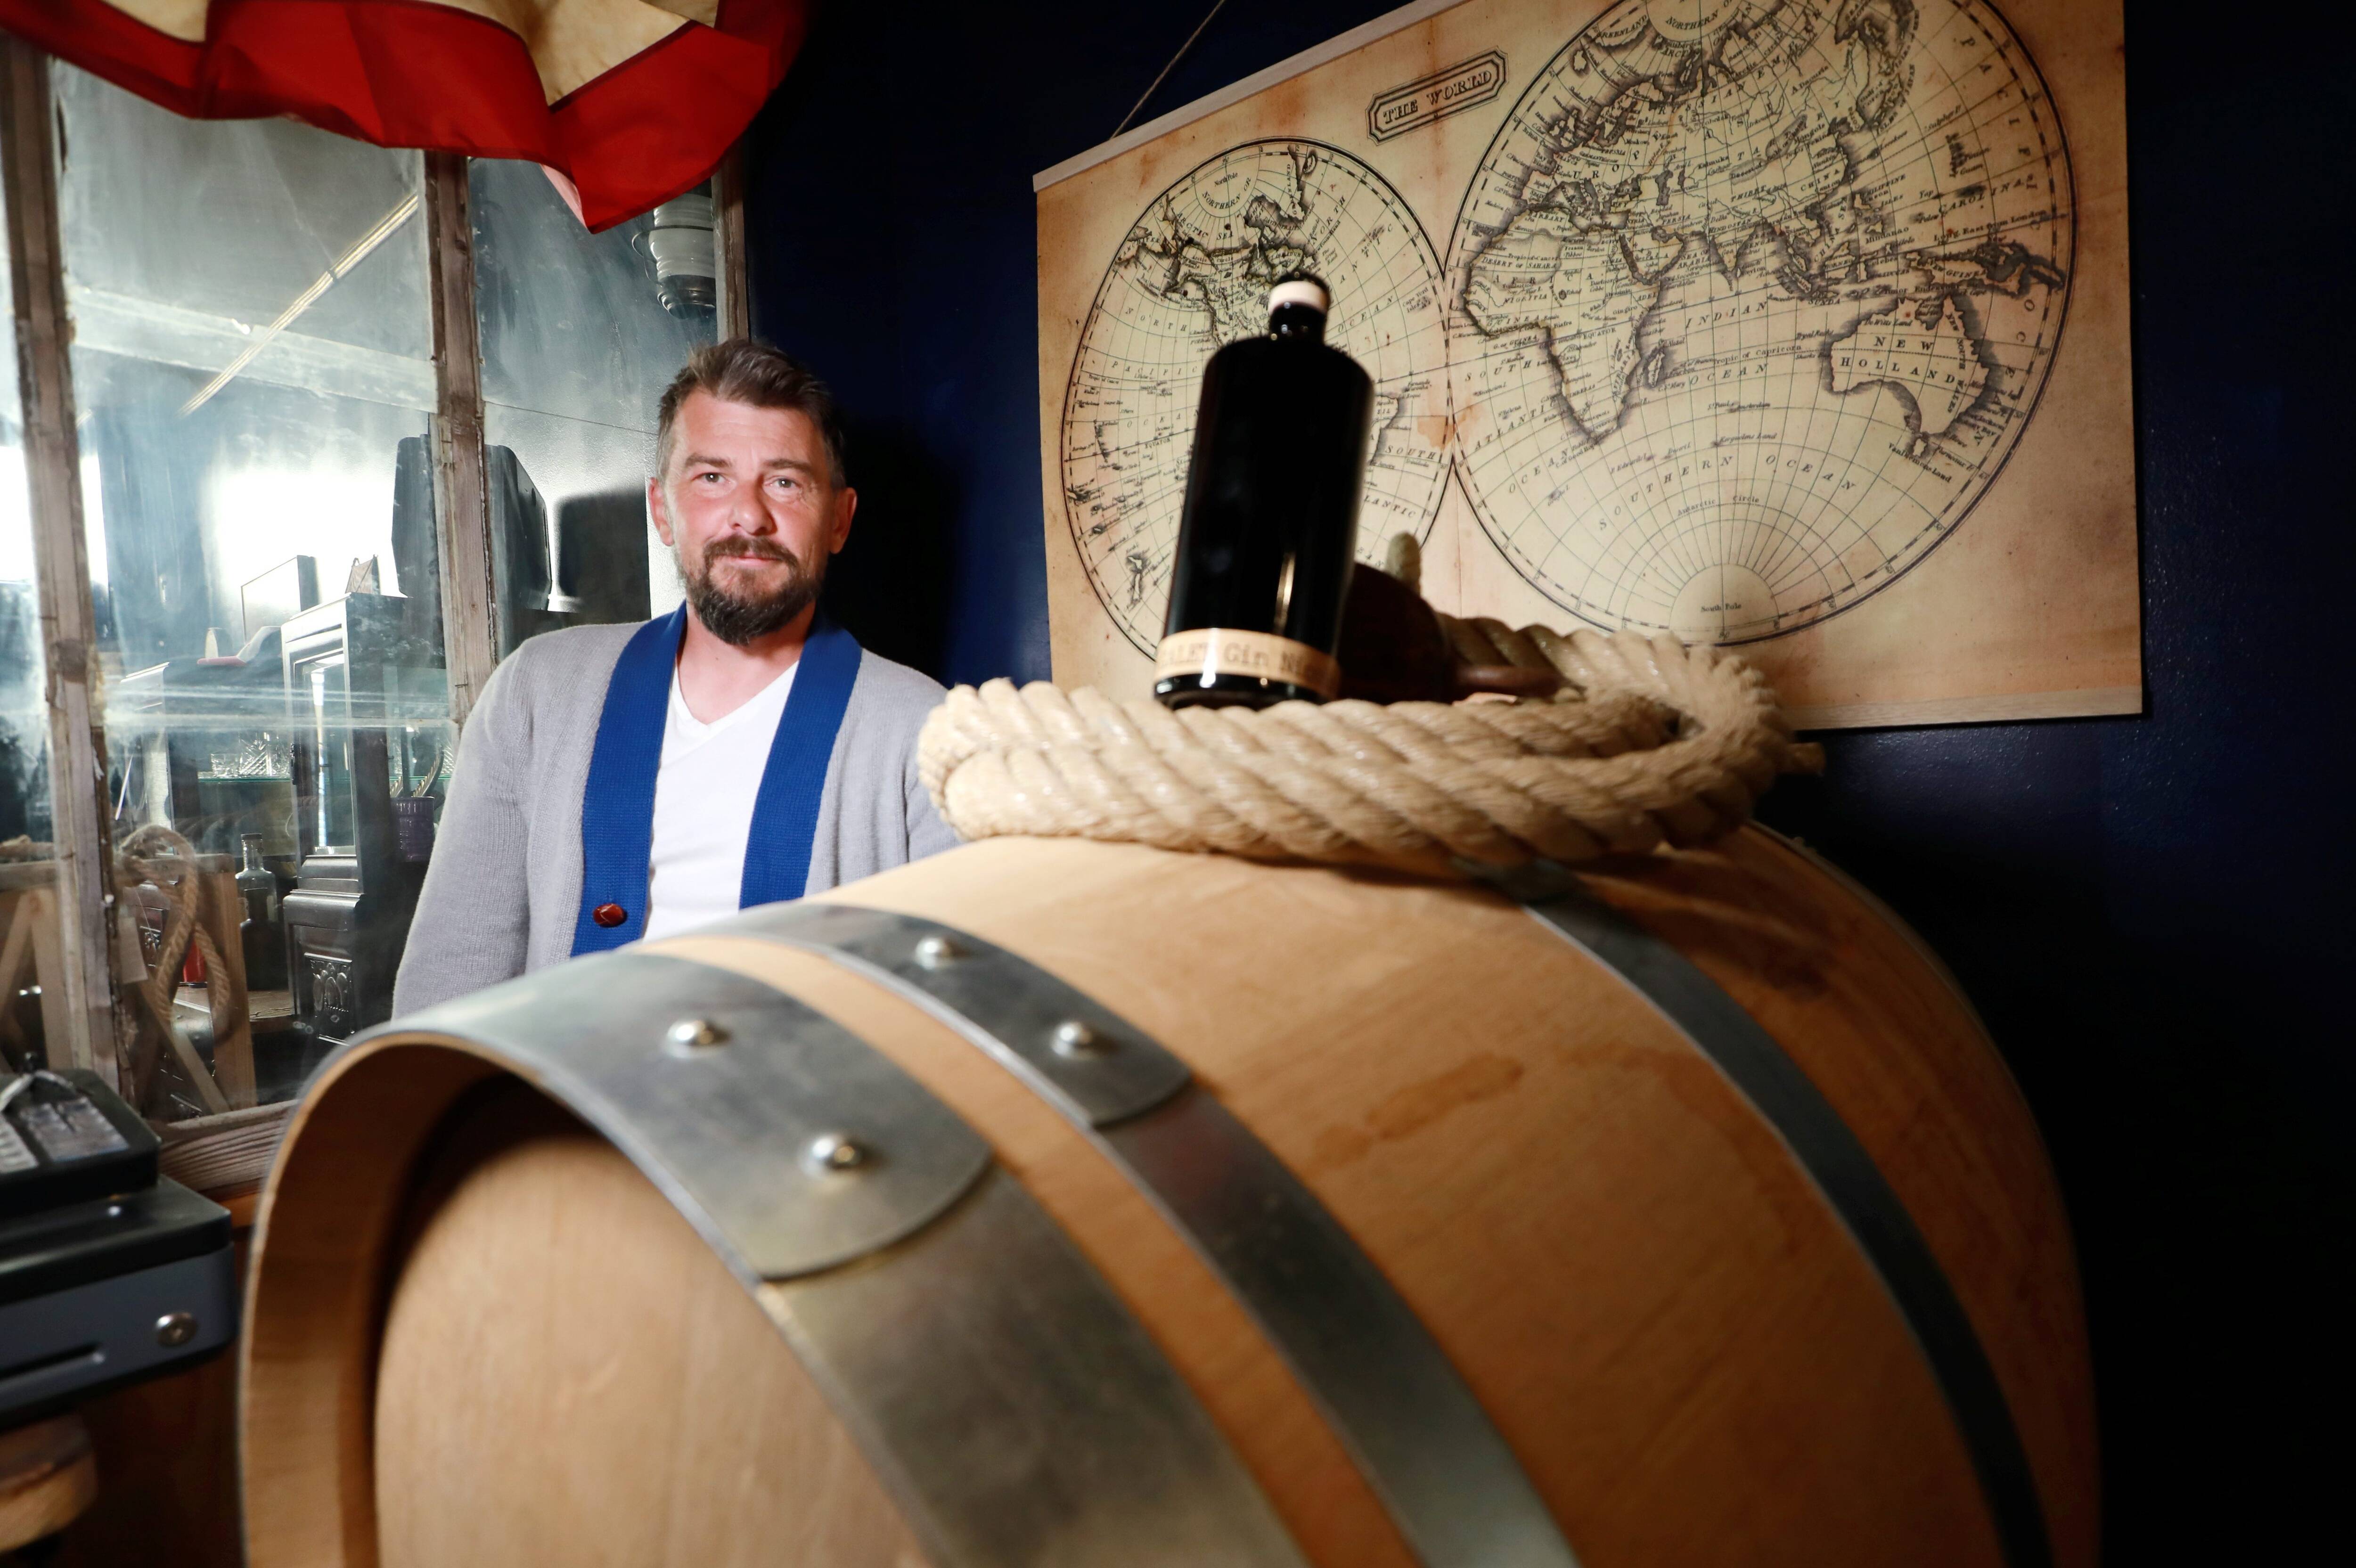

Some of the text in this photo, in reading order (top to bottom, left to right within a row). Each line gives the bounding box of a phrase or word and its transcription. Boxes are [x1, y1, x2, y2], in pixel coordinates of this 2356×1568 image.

[1597, 15, 1648, 39] GREENLAND
[1665, 9, 1719, 31] NORTHERN
[1383, 71, 1492, 124] THE WORLD
[1214, 172, 1238, 187] North Pole
[1800, 169, 1840, 191] CHINA
[1202, 191, 1241, 210] NORTHERN
[1176, 212, 1234, 240] ARCTIC SEA
[1313, 196, 1346, 245] NORTH
[1662, 214, 1691, 225] PERSIA
[1482, 256, 1513, 269] DESERT
[1493, 272, 1594, 285] AFRICA
[1402, 286, 1429, 307] Cape Verd
[1125, 307, 1187, 332] NORTH
[1338, 296, 1394, 332] OCEAN
[1685, 301, 1767, 329] INDIAN
[1583, 327, 1617, 339] EQUATOR
[1873, 336, 1934, 351] NEW
[1742, 351, 1751, 359] of
[1111, 360, 1198, 376] PACIFIC
[1464, 359, 1532, 382] SOUTH
[1690, 363, 1769, 385] OCEAN
[1840, 357, 1955, 384] HOLLAND
[1474, 400, 1556, 451] ATLANTIC
[1385, 444, 1438, 460] SOUTH
[1509, 448, 1570, 494] OCEAN
[1931, 467, 1953, 483] Land
[1599, 454, 1857, 531] SOUTHERN OCEAN
[1364, 495, 1416, 518] LANTIC
[1677, 494, 1760, 517] Antarctic Circle
[1700, 602, 1742, 613] South Pole
